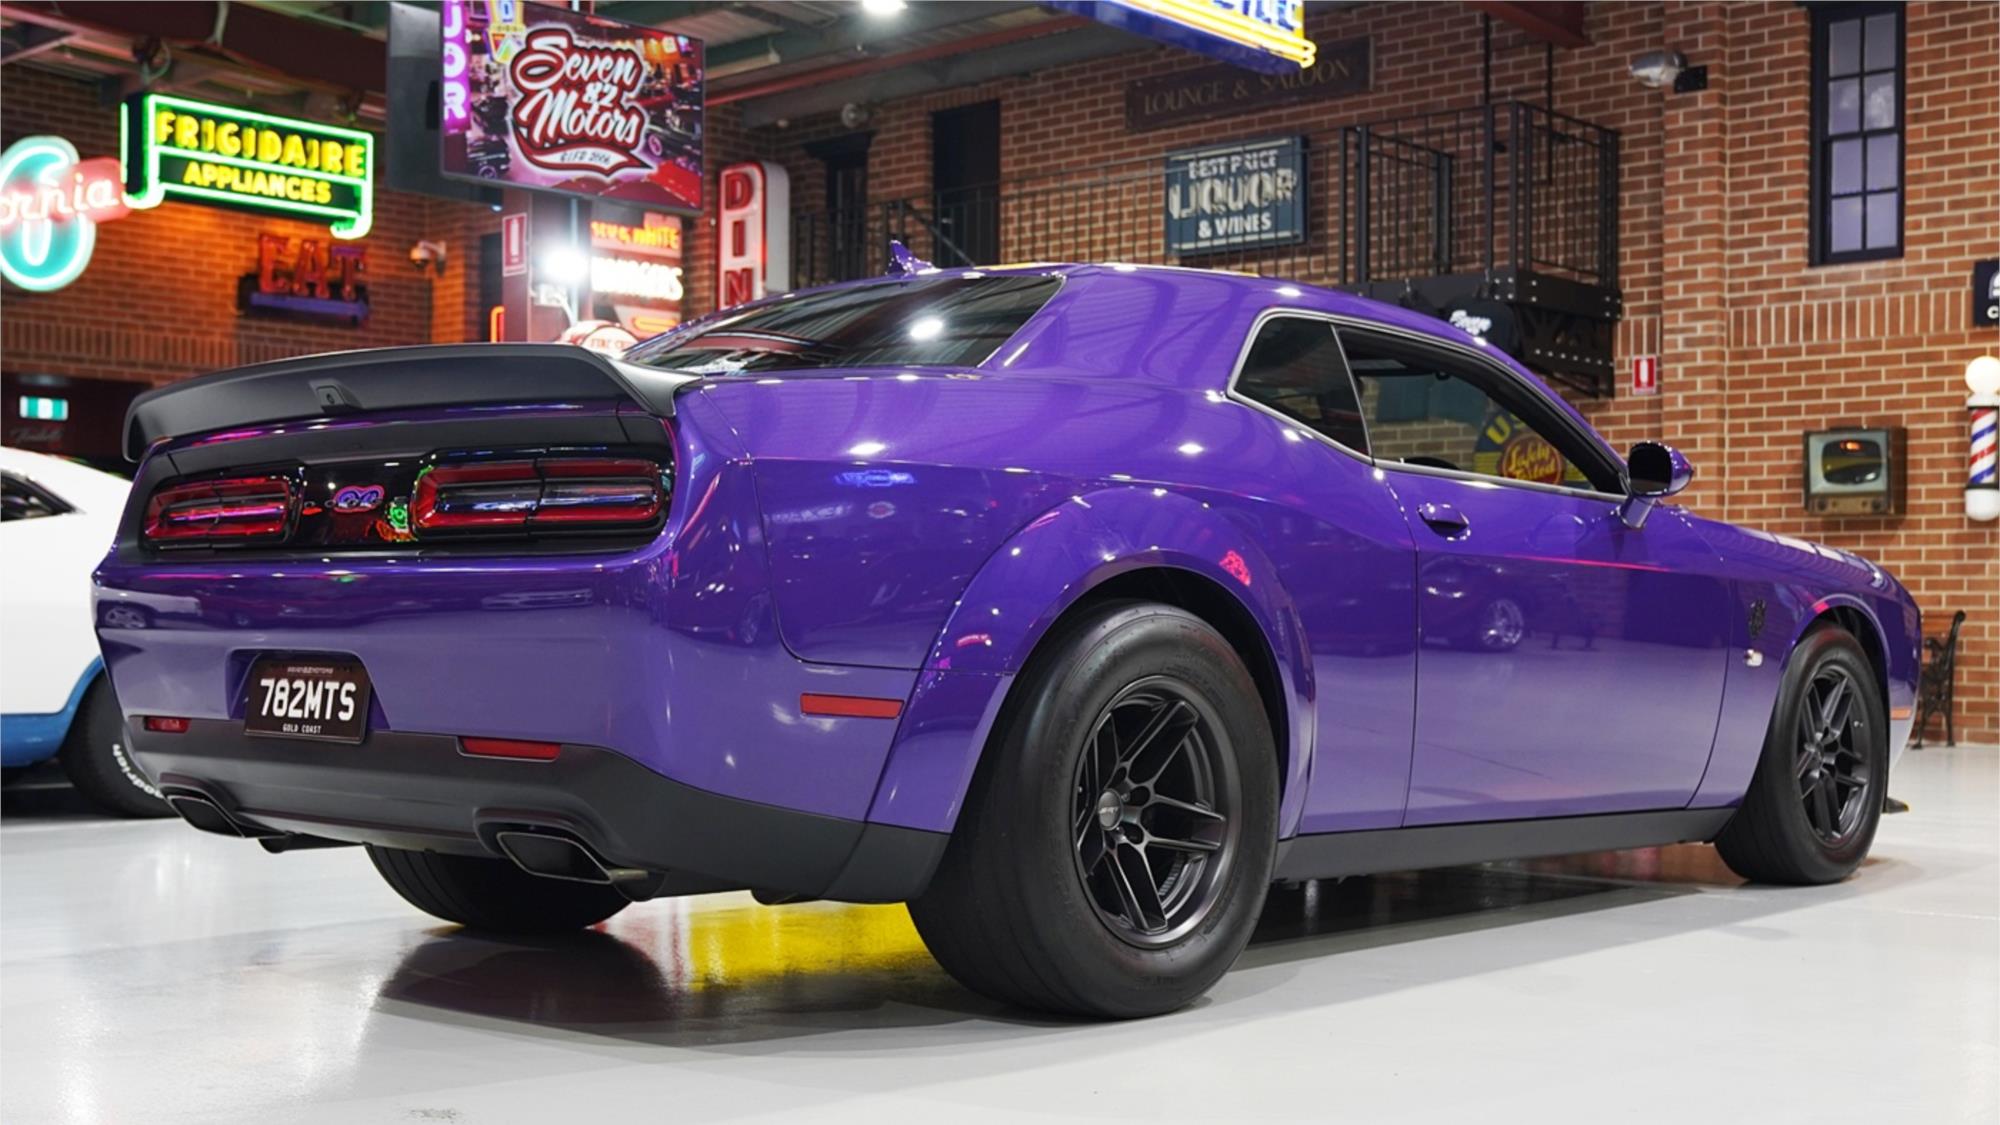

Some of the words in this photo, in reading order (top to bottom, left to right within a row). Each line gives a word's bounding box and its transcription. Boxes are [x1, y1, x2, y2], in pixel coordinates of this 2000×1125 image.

[516, 36, 638, 90] Seven
[519, 88, 640, 144] Motors
[583, 82, 618, 107] 82
[1144, 82, 1224, 115] LOUNGE
[1232, 80, 1248, 99] &
[155, 110, 366, 177] FRIGIDAIRE
[183, 161, 332, 204] APPLIANCES
[1188, 156, 1228, 180] BEST
[1168, 168, 1297, 220] LIQUOR
[1198, 220, 1213, 239] &
[1214, 212, 1272, 236] WINES
[259, 233, 367, 303] EAT
[260, 678, 357, 721] 782MTS
[282, 723, 299, 733] GOLD
[301, 724, 322, 734] COAST
